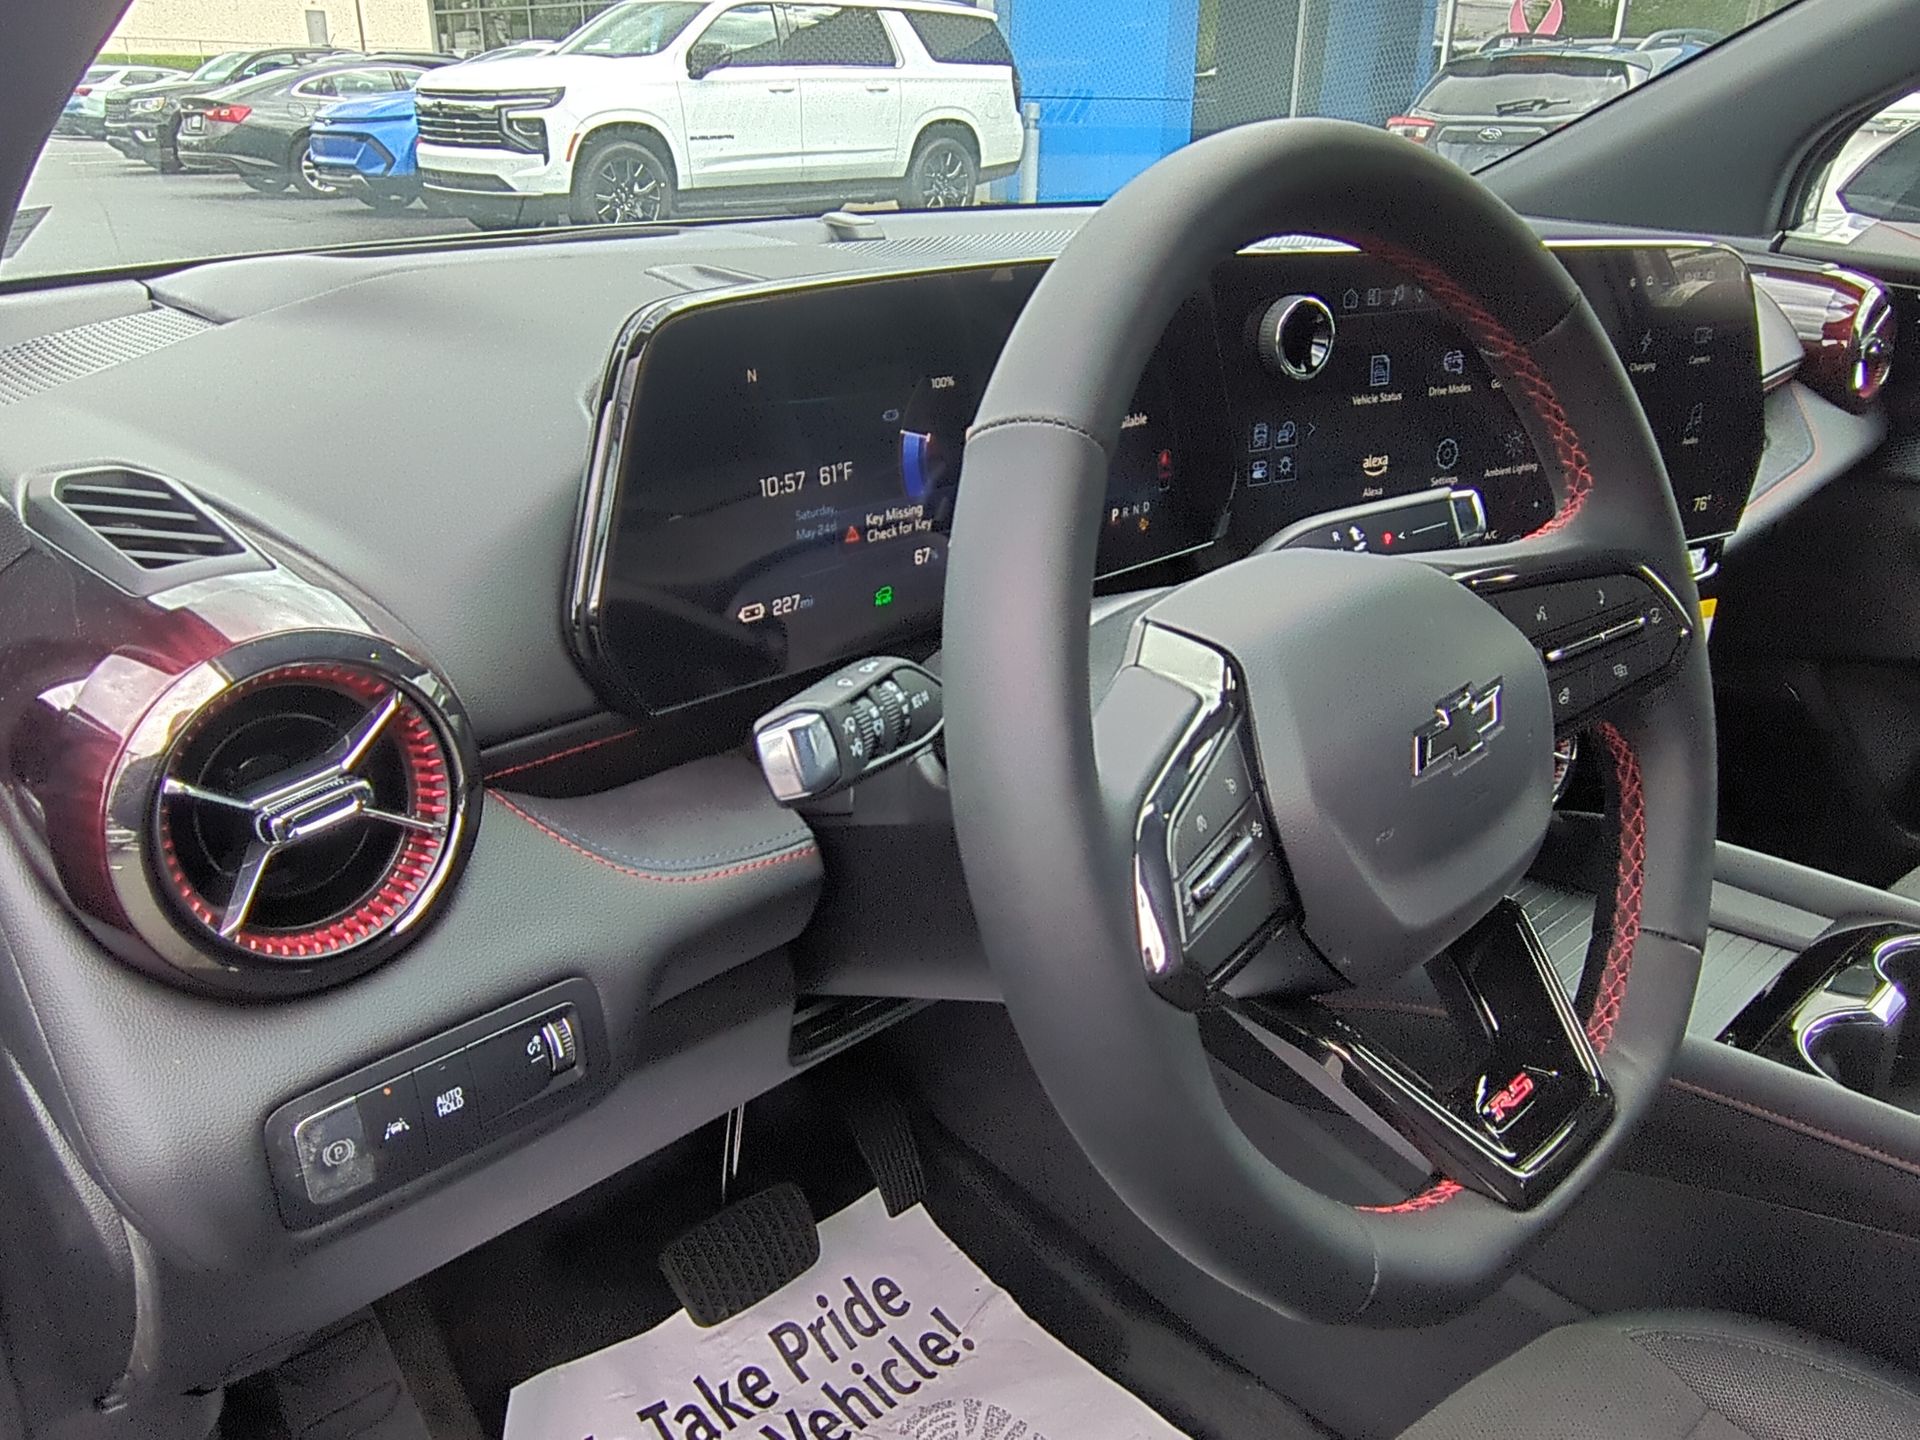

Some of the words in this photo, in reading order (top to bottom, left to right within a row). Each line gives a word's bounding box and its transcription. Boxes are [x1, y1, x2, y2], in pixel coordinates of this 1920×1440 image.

[747, 369, 757, 382] N
[931, 375, 955, 389] 100%
[1428, 385, 1448, 397] Drive
[1449, 383, 1472, 394] Modes
[1352, 394, 1379, 406] Vehicle
[1380, 391, 1403, 402] Status
[1362, 454, 1389, 469] alexa
[759, 470, 806, 497] 10:57
[1430, 476, 1459, 488] Settings
[1362, 488, 1383, 498] Alexa
[866, 512, 884, 526] Key
[885, 504, 924, 521] Missing
[1111, 508, 1119, 521] P
[1122, 507, 1129, 517] R
[1133, 505, 1140, 515] N
[1143, 501, 1150, 512] D
[867, 526, 898, 543] Check
[899, 523, 913, 535] for
[915, 517, 932, 533] Key
[1332, 531, 1341, 542] R
[436, 1086, 462, 1107] AUTO
[437, 1096, 465, 1117] HOLD
[636, 1376, 778, 1440] Take
[769, 1276, 911, 1383] Pride
